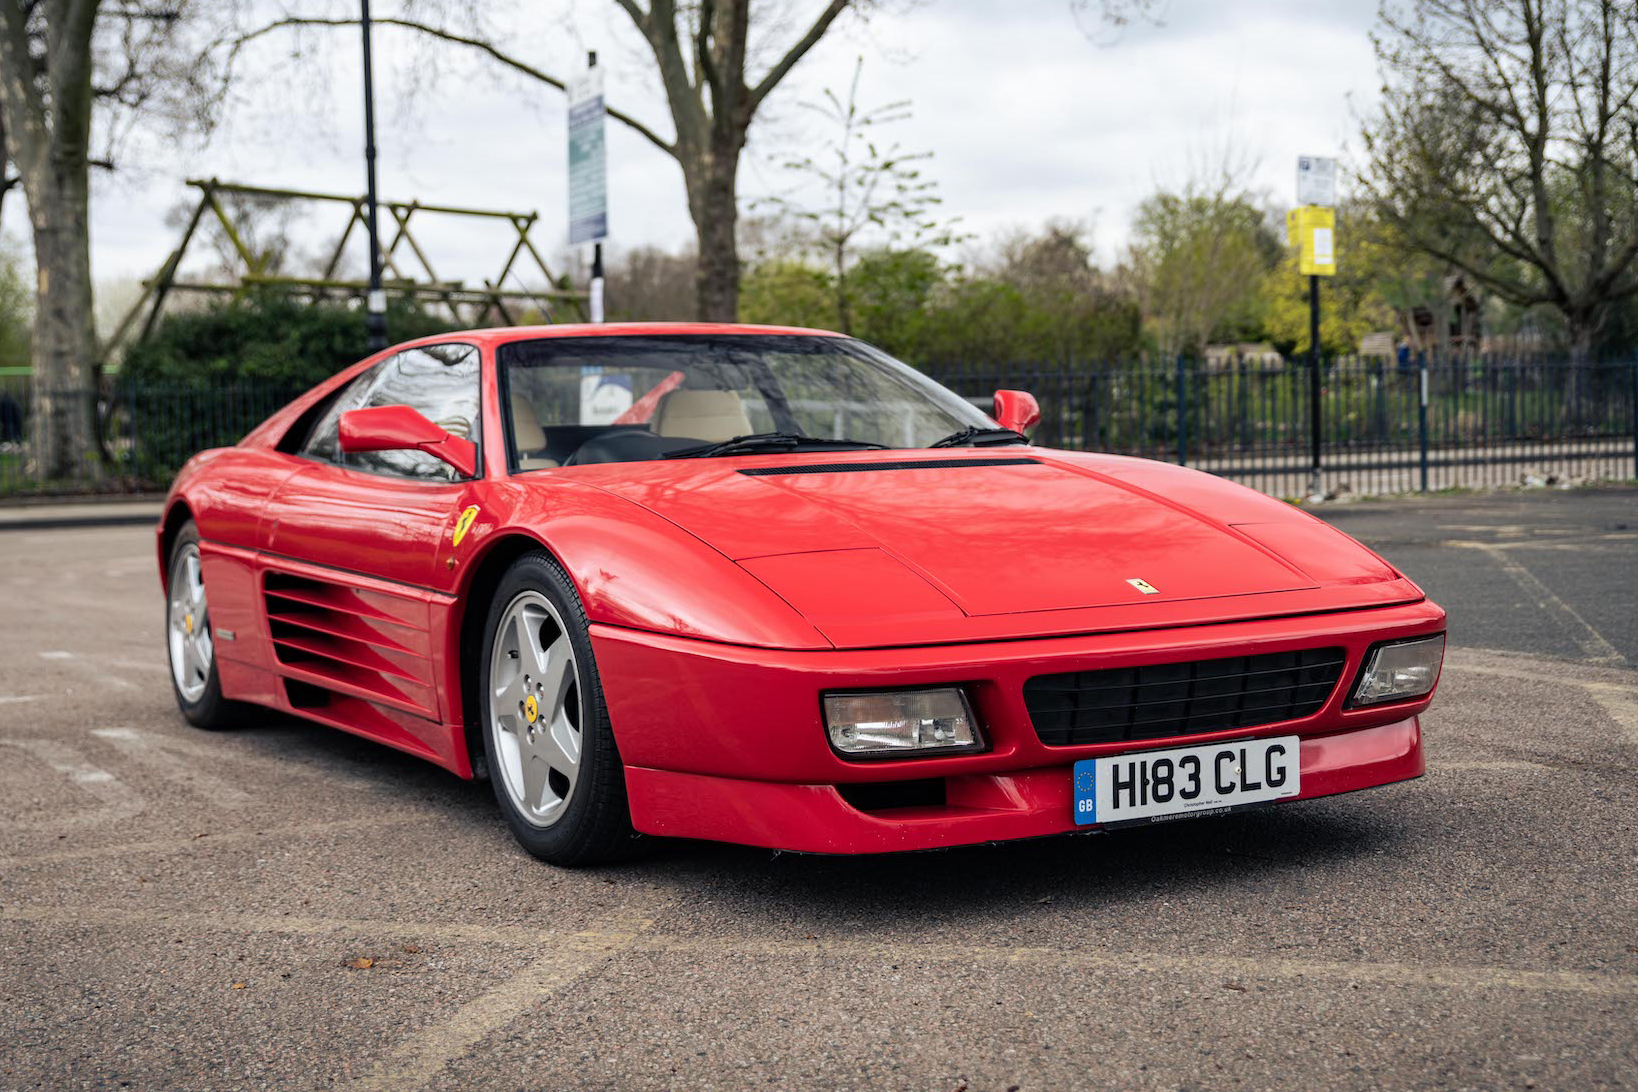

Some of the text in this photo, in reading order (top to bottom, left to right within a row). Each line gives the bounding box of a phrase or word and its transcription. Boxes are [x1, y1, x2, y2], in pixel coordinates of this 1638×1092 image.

[1112, 744, 1287, 810] H183 CLG
[1078, 798, 1093, 813] GB
[1151, 806, 1232, 823] Oakmeremotorgroup.co.uk
